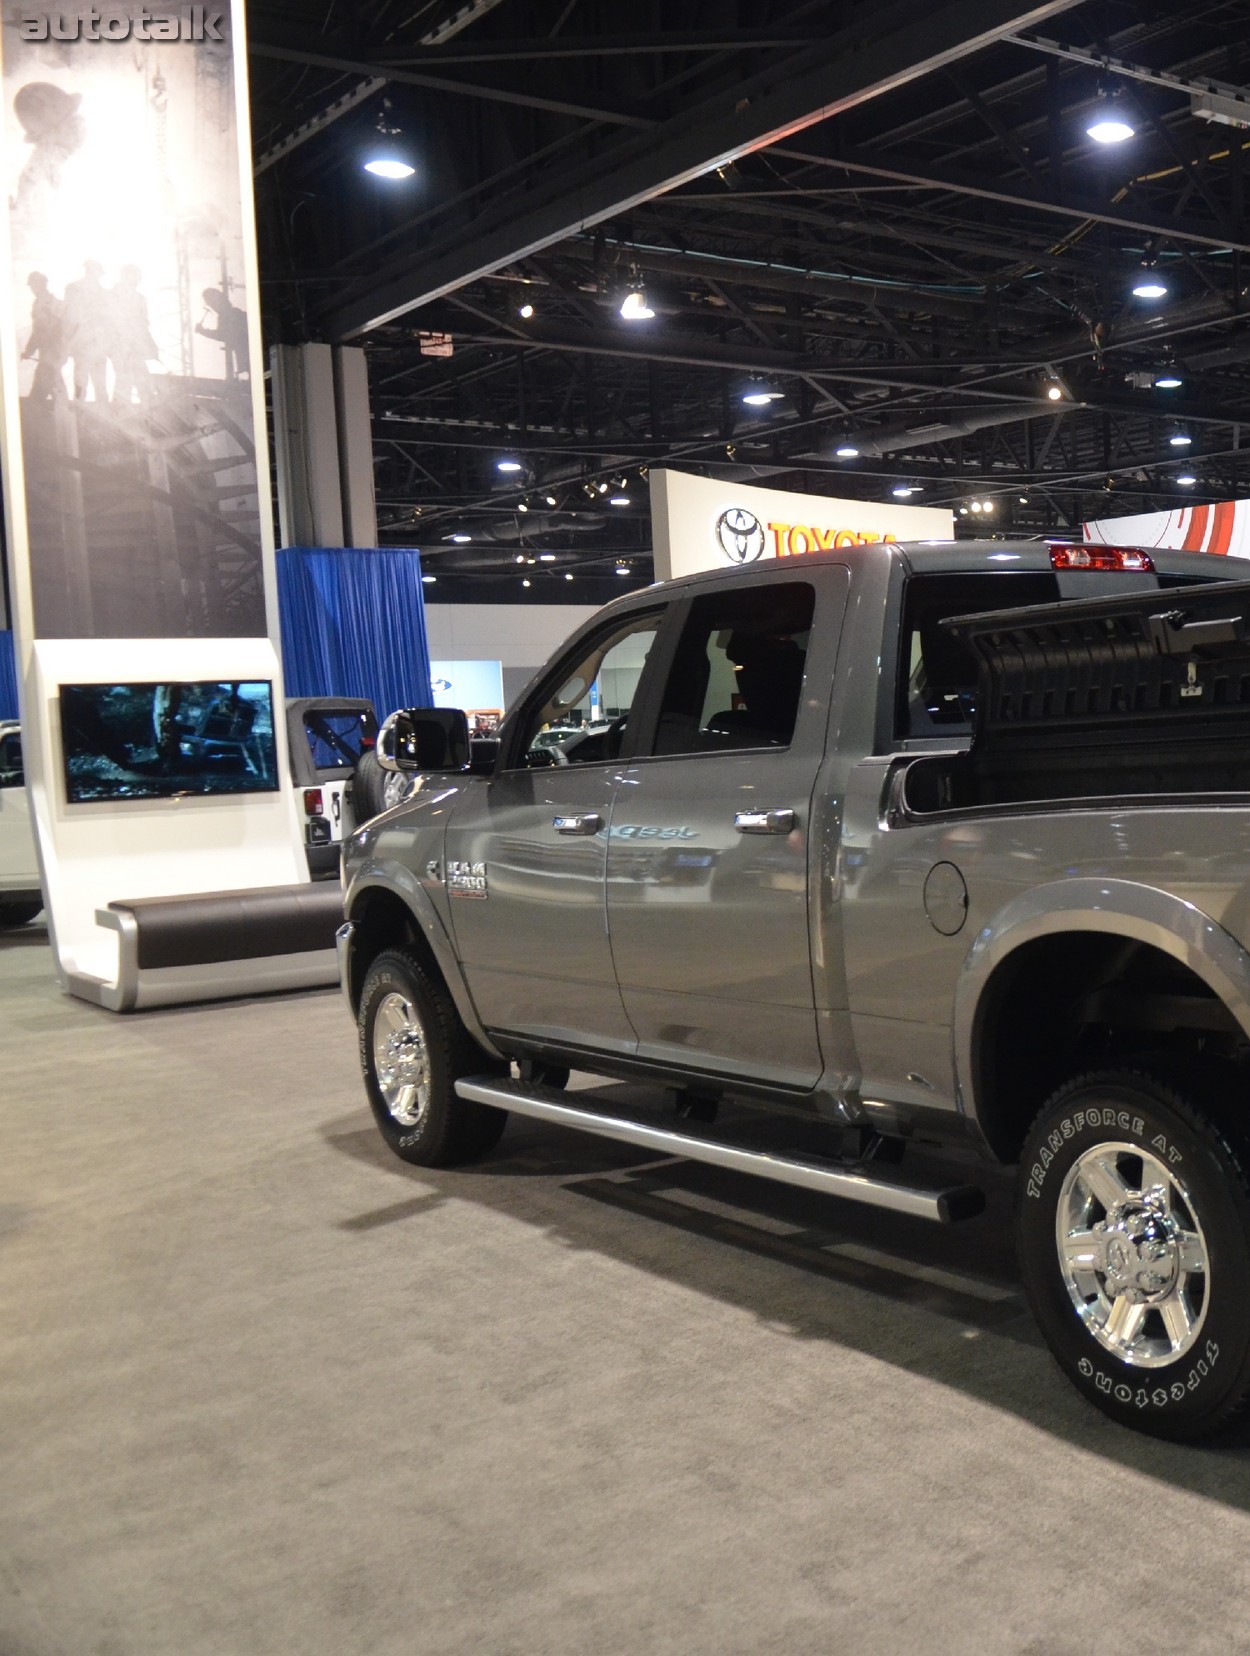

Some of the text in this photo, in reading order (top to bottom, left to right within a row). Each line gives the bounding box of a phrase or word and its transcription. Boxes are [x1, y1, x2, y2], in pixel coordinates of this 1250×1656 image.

[768, 522, 897, 558] TOYOT
[1027, 1108, 1182, 1199] TRANSFORCE AT
